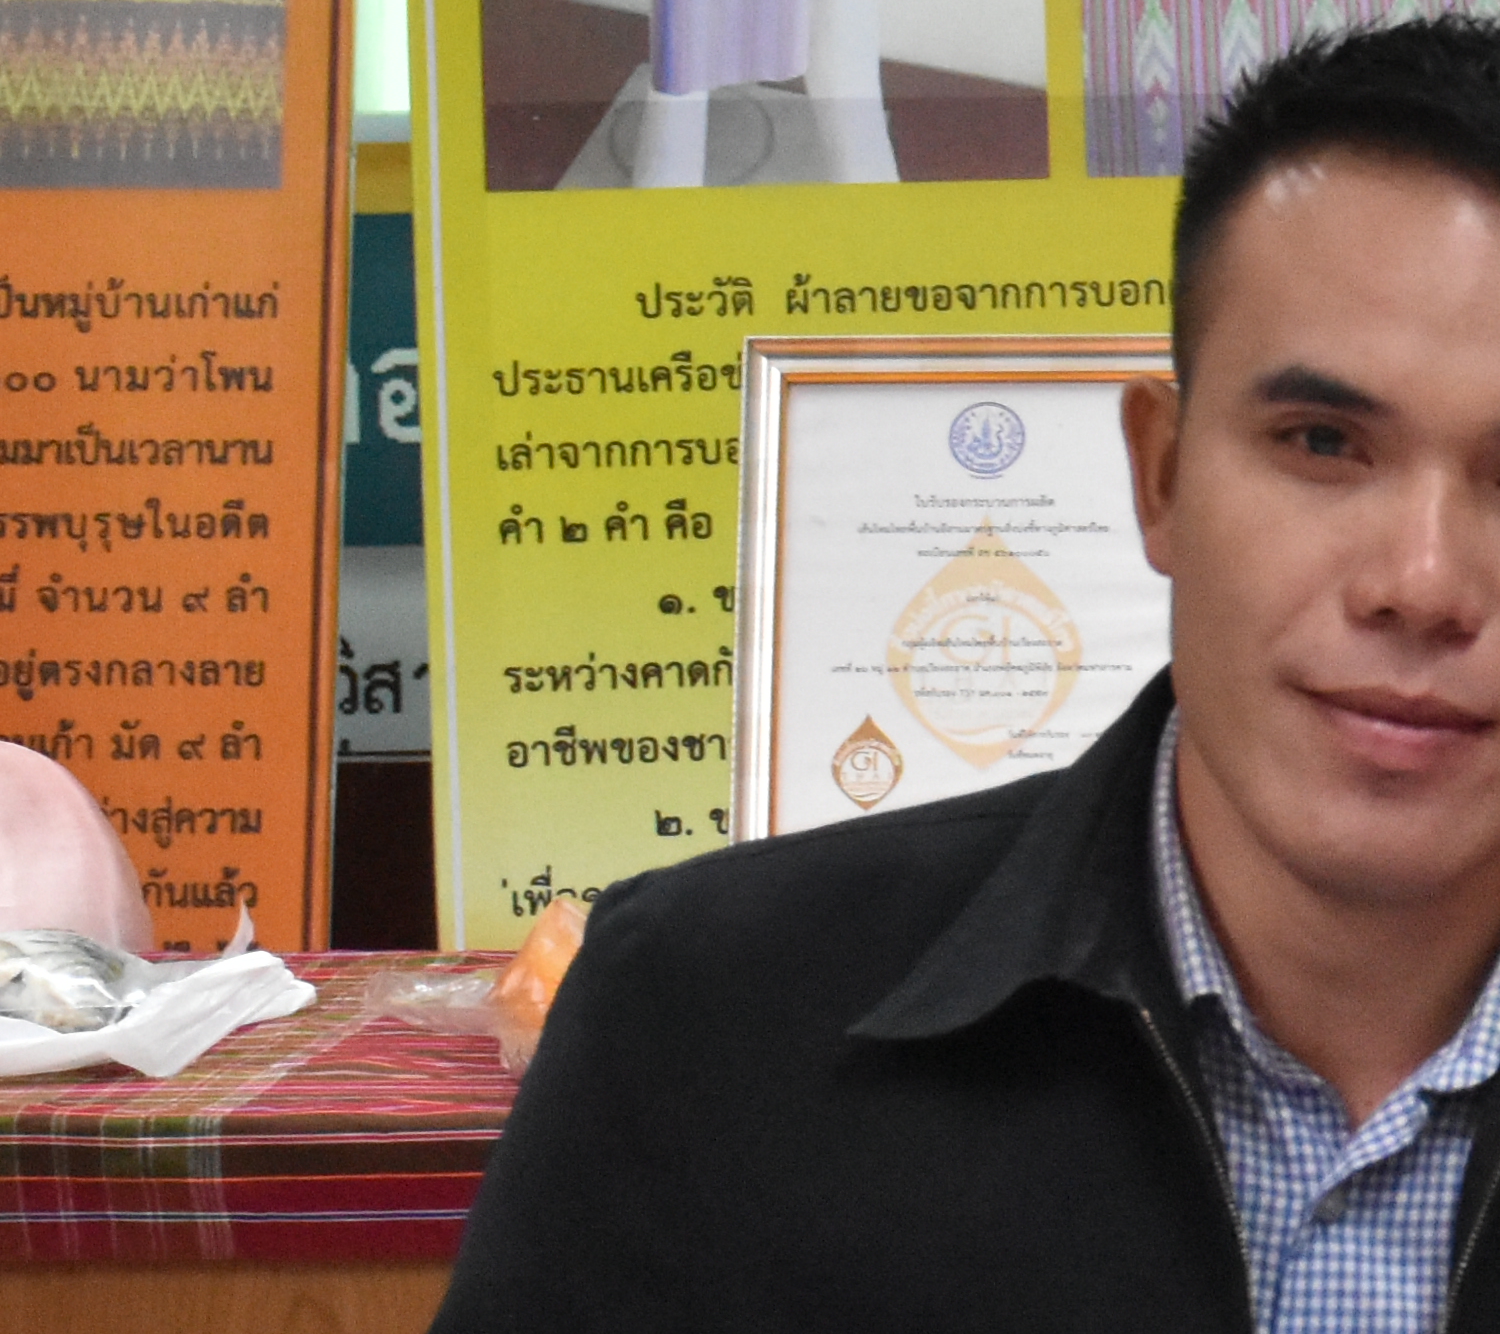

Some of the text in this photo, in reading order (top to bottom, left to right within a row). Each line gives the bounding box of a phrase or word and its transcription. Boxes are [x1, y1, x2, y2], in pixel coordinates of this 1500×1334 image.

[635, 276, 754, 319] ประวัติ
[499, 498, 713, 545] คำ ๒ คำ คือ
[36, 572, 163, 613] จำนวน
